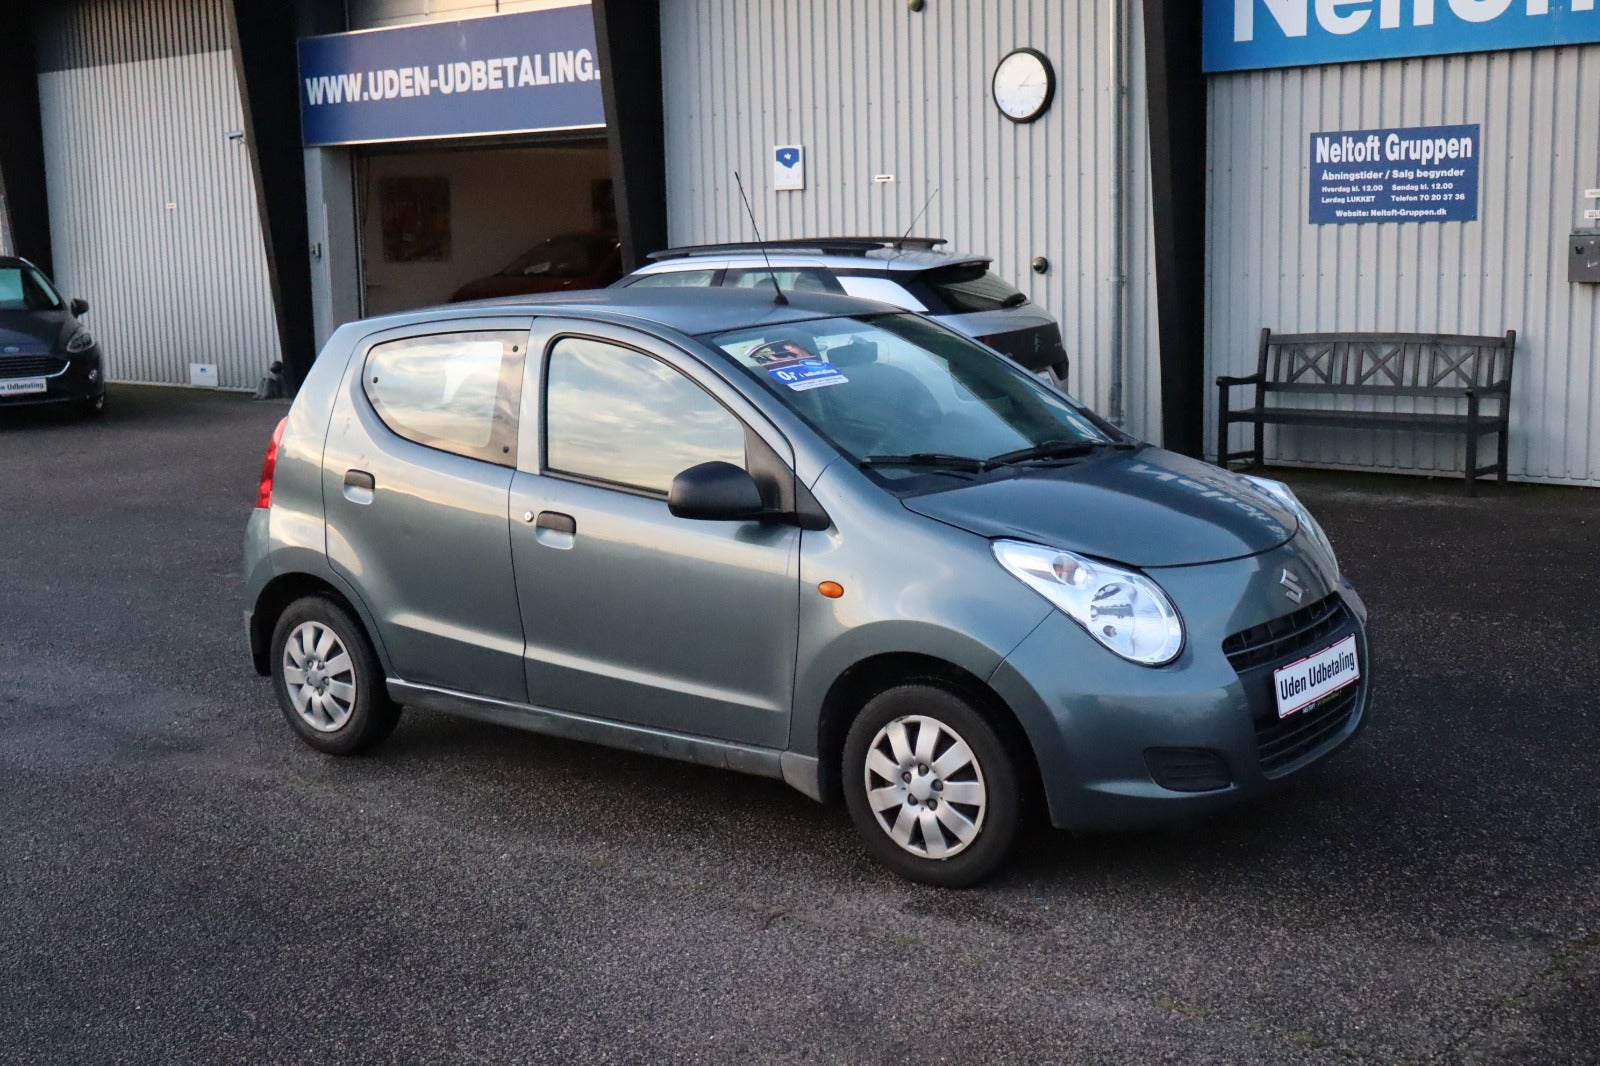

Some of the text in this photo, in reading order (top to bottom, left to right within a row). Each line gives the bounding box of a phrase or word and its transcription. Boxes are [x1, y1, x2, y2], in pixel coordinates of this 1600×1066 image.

[1316, 133, 1472, 165] Neltoft Gruppen
[1321, 168, 1465, 182] Åbningstider / Salg begynder
[1346, 195, 1375, 203] LUKKET
[1335, 208, 1447, 217] Website: Neltoft-Gruppen.dk
[1280, 652, 1355, 700] Uden Udbetaling
